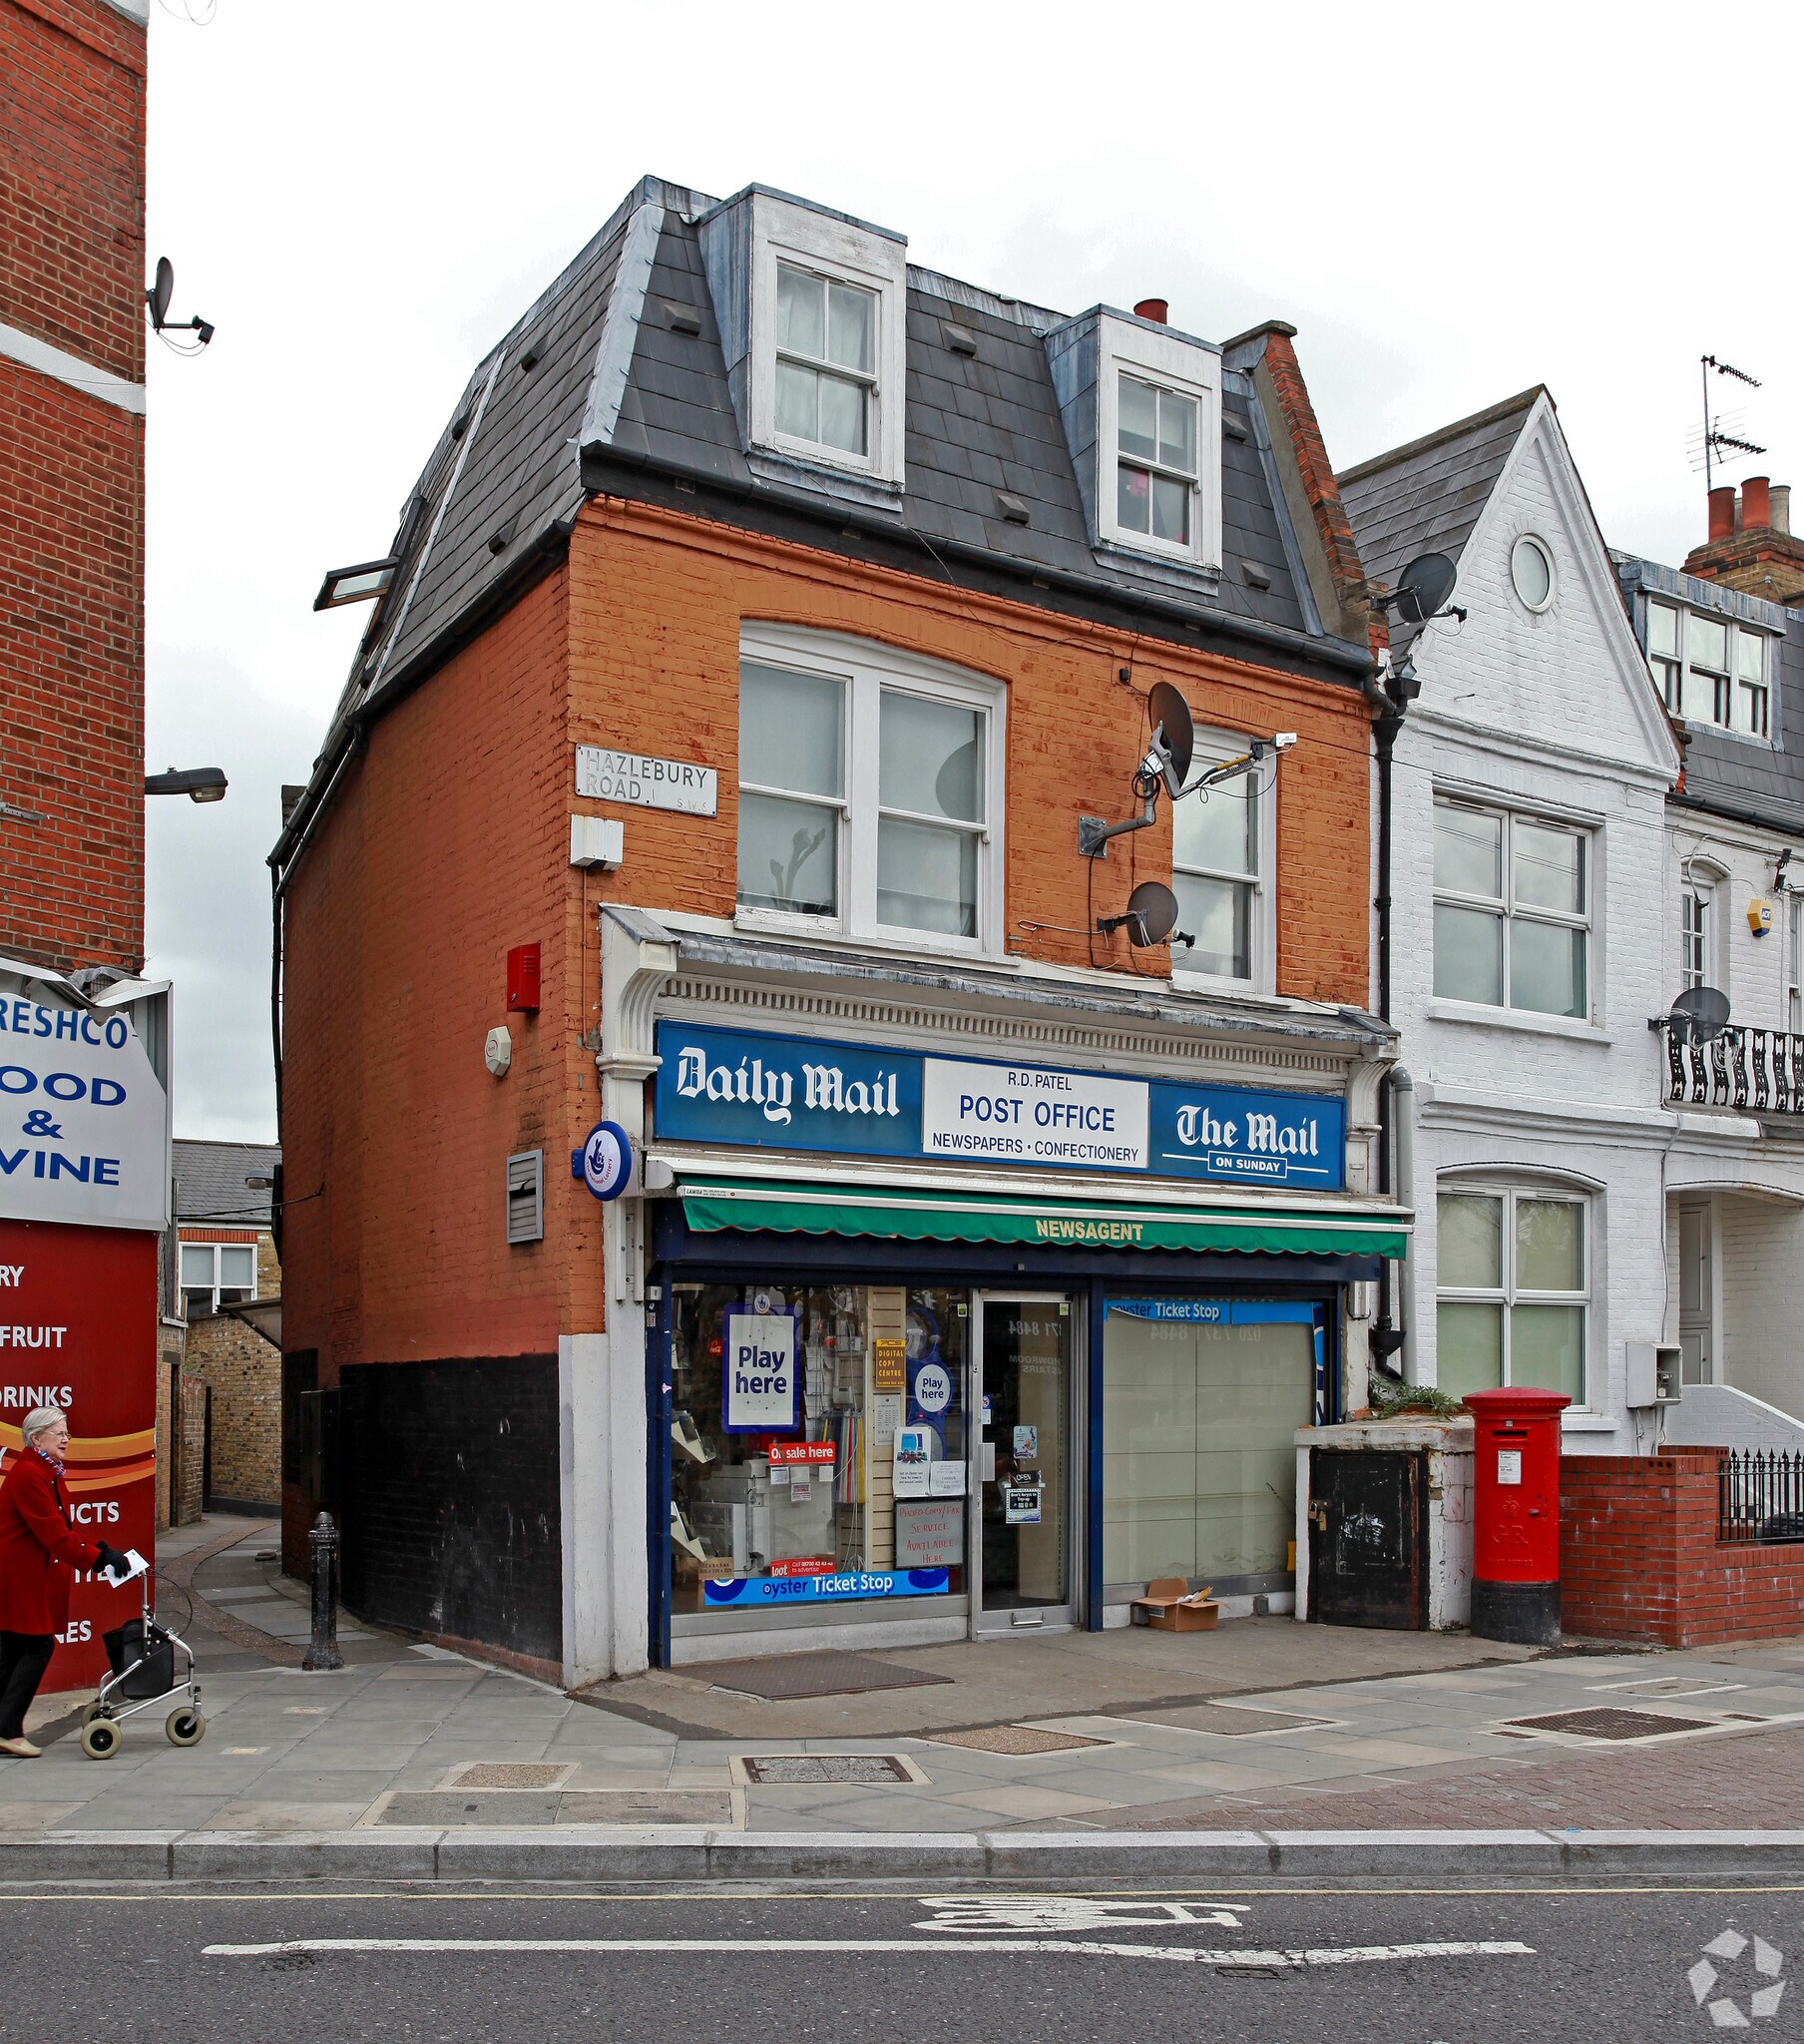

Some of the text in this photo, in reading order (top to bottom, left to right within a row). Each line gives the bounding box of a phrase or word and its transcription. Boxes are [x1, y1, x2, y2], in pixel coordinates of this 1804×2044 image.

[586, 750, 707, 788] HAZLEBURY
[586, 772, 642, 800] ROAD
[676, 1046, 900, 1126] Daily Mail
[22, 1110, 65, 1140] &
[960, 1095, 1116, 1132] POST OFFICE
[1175, 1105, 1319, 1157] The Mail
[933, 1132, 1138, 1162] NEWSPAPERS CONFECTIONERY
[1215, 1157, 1281, 1173] ON SUNDAY
[1036, 1219, 1143, 1241] NEWSAGENT
[1154, 1302, 1190, 1317] Ticket
[1192, 1302, 1220, 1320] Stop
[0, 1325, 67, 1347] FRUIT
[738, 1345, 786, 1374] Play
[735, 1371, 787, 1394] here
[921, 1388, 944, 1399] here
[922, 1377, 943, 1390] Play
[0, 1385, 73, 1408] RINKS
[785, 1446, 806, 1459] sale
[808, 1445, 833, 1458] here
[922, 1554, 944, 1564] HERE
[762, 1573, 894, 1599] oyster Ticket Stop
[55, 1620, 92, 1644] ES
